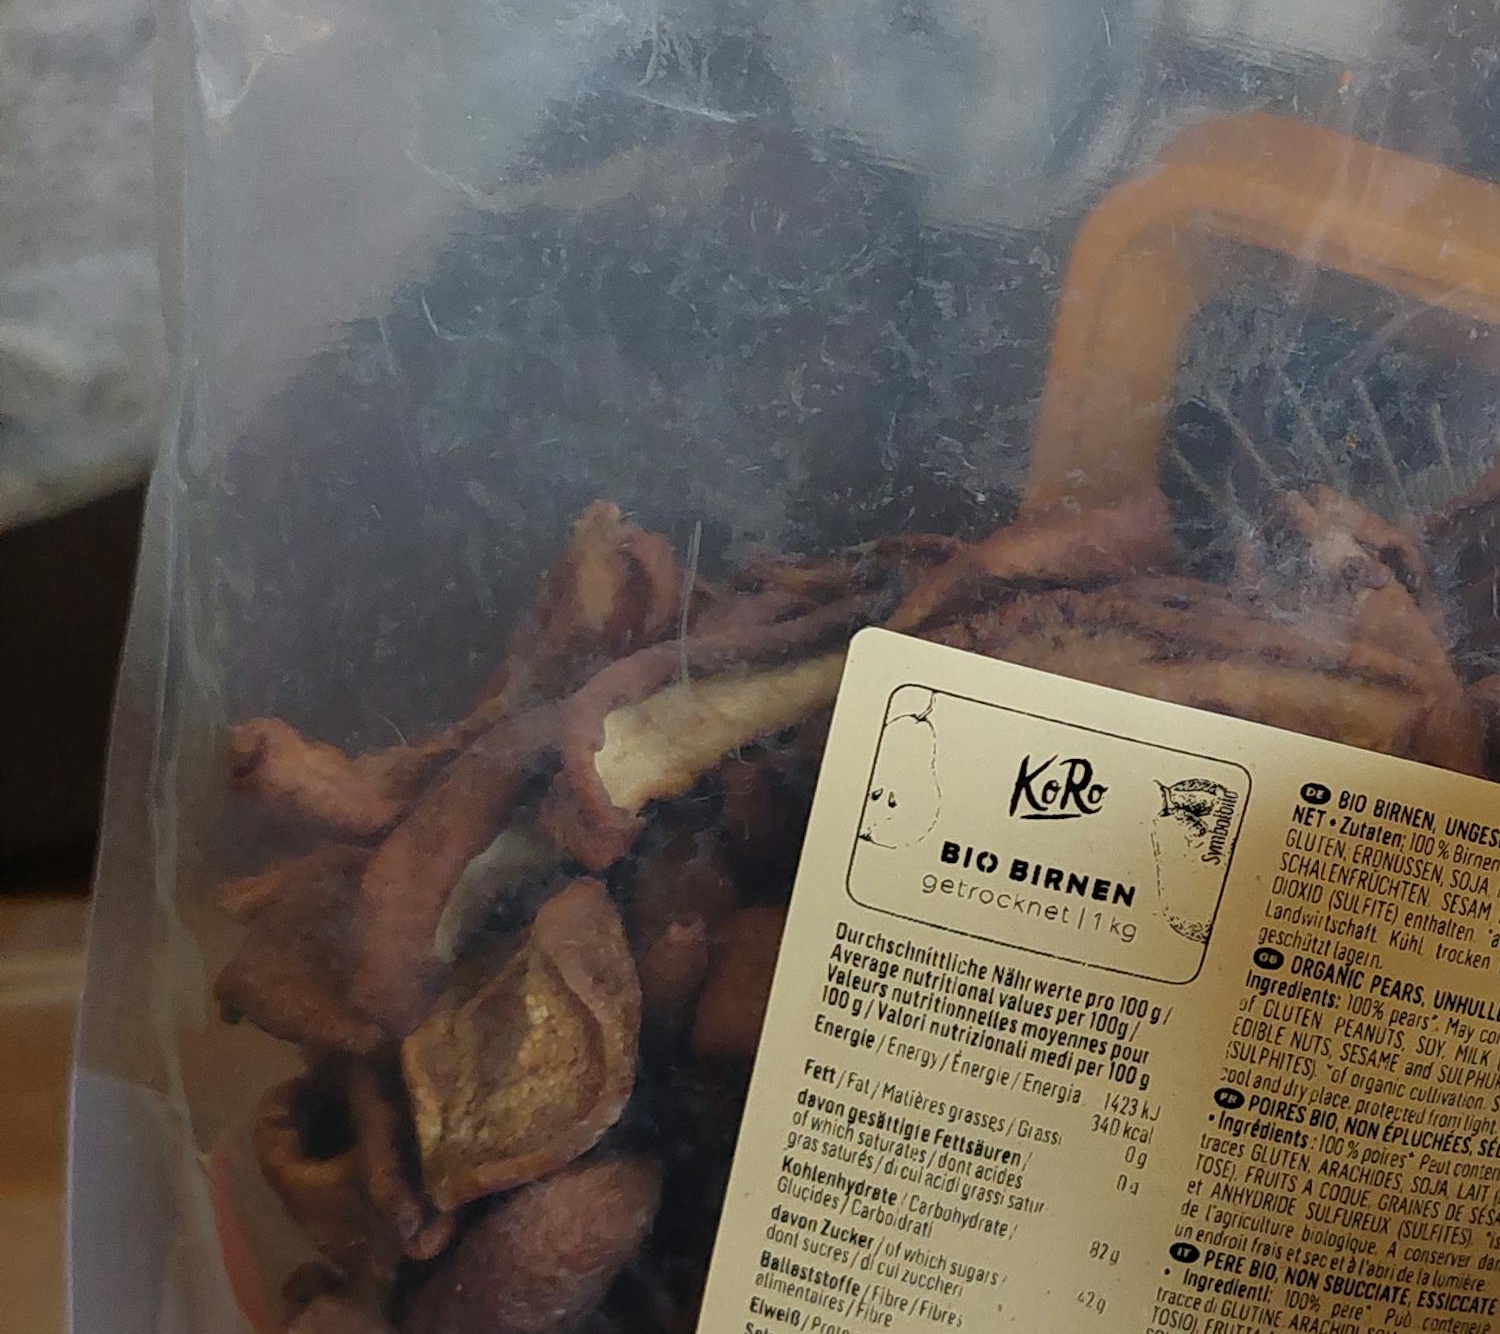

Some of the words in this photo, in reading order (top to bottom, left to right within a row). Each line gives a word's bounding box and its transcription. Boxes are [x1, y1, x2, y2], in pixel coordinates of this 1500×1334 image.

[1010, 755, 1108, 819] KoRo
[1339, 791, 1367, 813] BIO
[1371, 798, 1441, 834] BIRNEN,
[1201, 788, 1240, 865] Symbolbild
[1291, 803, 1327, 829] NET
[1407, 832, 1436, 856] 100
[941, 841, 998, 873] BIO
[1009, 859, 1135, 907] BIRNEN
[920, 868, 1072, 927] getrocknet
[1095, 913, 1102, 930] 1
[1107, 917, 1138, 943] kg
[1271, 875, 1324, 904] DIOXID
[1326, 889, 1401, 927] (SULFITE)
[1439, 891, 1493, 921] SESAM
[1289, 954, 1365, 989] ORGANIC
[1434, 940, 1493, 970] trocken
[829, 942, 900, 982] Average
[902, 963, 996, 1004] nutritional
[997, 989, 1054, 1020] values
[1055, 1008, 1086, 1029] per
[1084, 992, 1114, 1015] pro
[1118, 996, 1149, 1019] 100
[1243, 969, 1342, 1013] Ingredients:
[1443, 1016, 1477, 1043] May
[813, 1014, 876, 1052] Energie
[886, 1036, 940, 1070] Energy
[820, 985, 850, 1009] 100
[876, 1001, 926, 1031] Valori
[928, 1016, 1028, 1059] nutrizionali
[1029, 1043, 1074, 1069] medi
[1074, 1058, 1104, 1080] per
[1107, 1062, 1138, 1084] 100
[825, 964, 889, 998] Valeurs
[891, 982, 1019, 1033] nutritionnelles
[1020, 1021, 1108, 1058] moyennes
[1109, 1043, 1149, 1068] pour
[1231, 1016, 1285, 1045] EDIBLE
[1338, 1043, 1400, 1072] SESAME
[1403, 1057, 1434, 1079] and
[1453, 1044, 1492, 1066] MILK
[803, 1057, 837, 1084] Fett
[846, 1071, 871, 1094] Fat
[947, 1104, 1005, 1135] grasses
[1103, 1092, 1139, 1116] 1423
[1140, 1101, 1162, 1122] kJ
[1252, 1071, 1282, 1094] and
[1353, 1095, 1427, 1128] protected
[1349, 1069, 1408, 1101] organic
[796, 1087, 846, 1117] davon
[933, 1127, 1022, 1167] Fettsäuren
[1122, 1121, 1154, 1144] kcal
[1247, 1094, 1307, 1124] POIRES
[1342, 1116, 1380, 1139] NON
[792, 1108, 808, 1127] of
[810, 1113, 855, 1141] which
[974, 1161, 1024, 1189] acides
[1199, 1131, 1247, 1157] traces
[1455, 1182, 1490, 1202] LAIT
[1317, 1135, 1345, 1156] 100
[780, 1155, 898, 1209] Kohlenhydrate
[907, 1194, 1009, 1240] Carbohydrate
[1210, 1182, 1297, 1215] ANHYDRIDE
[1304, 1202, 1392, 1234] SULFUREUX
[1244, 1165, 1298, 1192] FRUITS
[1376, 1193, 1441, 1218] GRAINES
[770, 1203, 819, 1233] davon
[820, 1219, 875, 1250] Zucker
[801, 1237, 850, 1263] sucres
[1174, 1223, 1193, 1239] un
[1195, 1224, 1249, 1251] endroit
[1250, 1236, 1284, 1259] frais
[1302, 1251, 1329, 1267] sec
[759, 1250, 862, 1296] Ballaststoffe
[1203, 1250, 1246, 1274] PERE
[1283, 1267, 1320, 1289] NON
[1415, 1291, 1499, 1315] ESSICCATE
[1403, 1246, 1471, 1267] conserver
[755, 1269, 846, 1313] alimentaires
[1155, 1285, 1203, 1310] tracce
